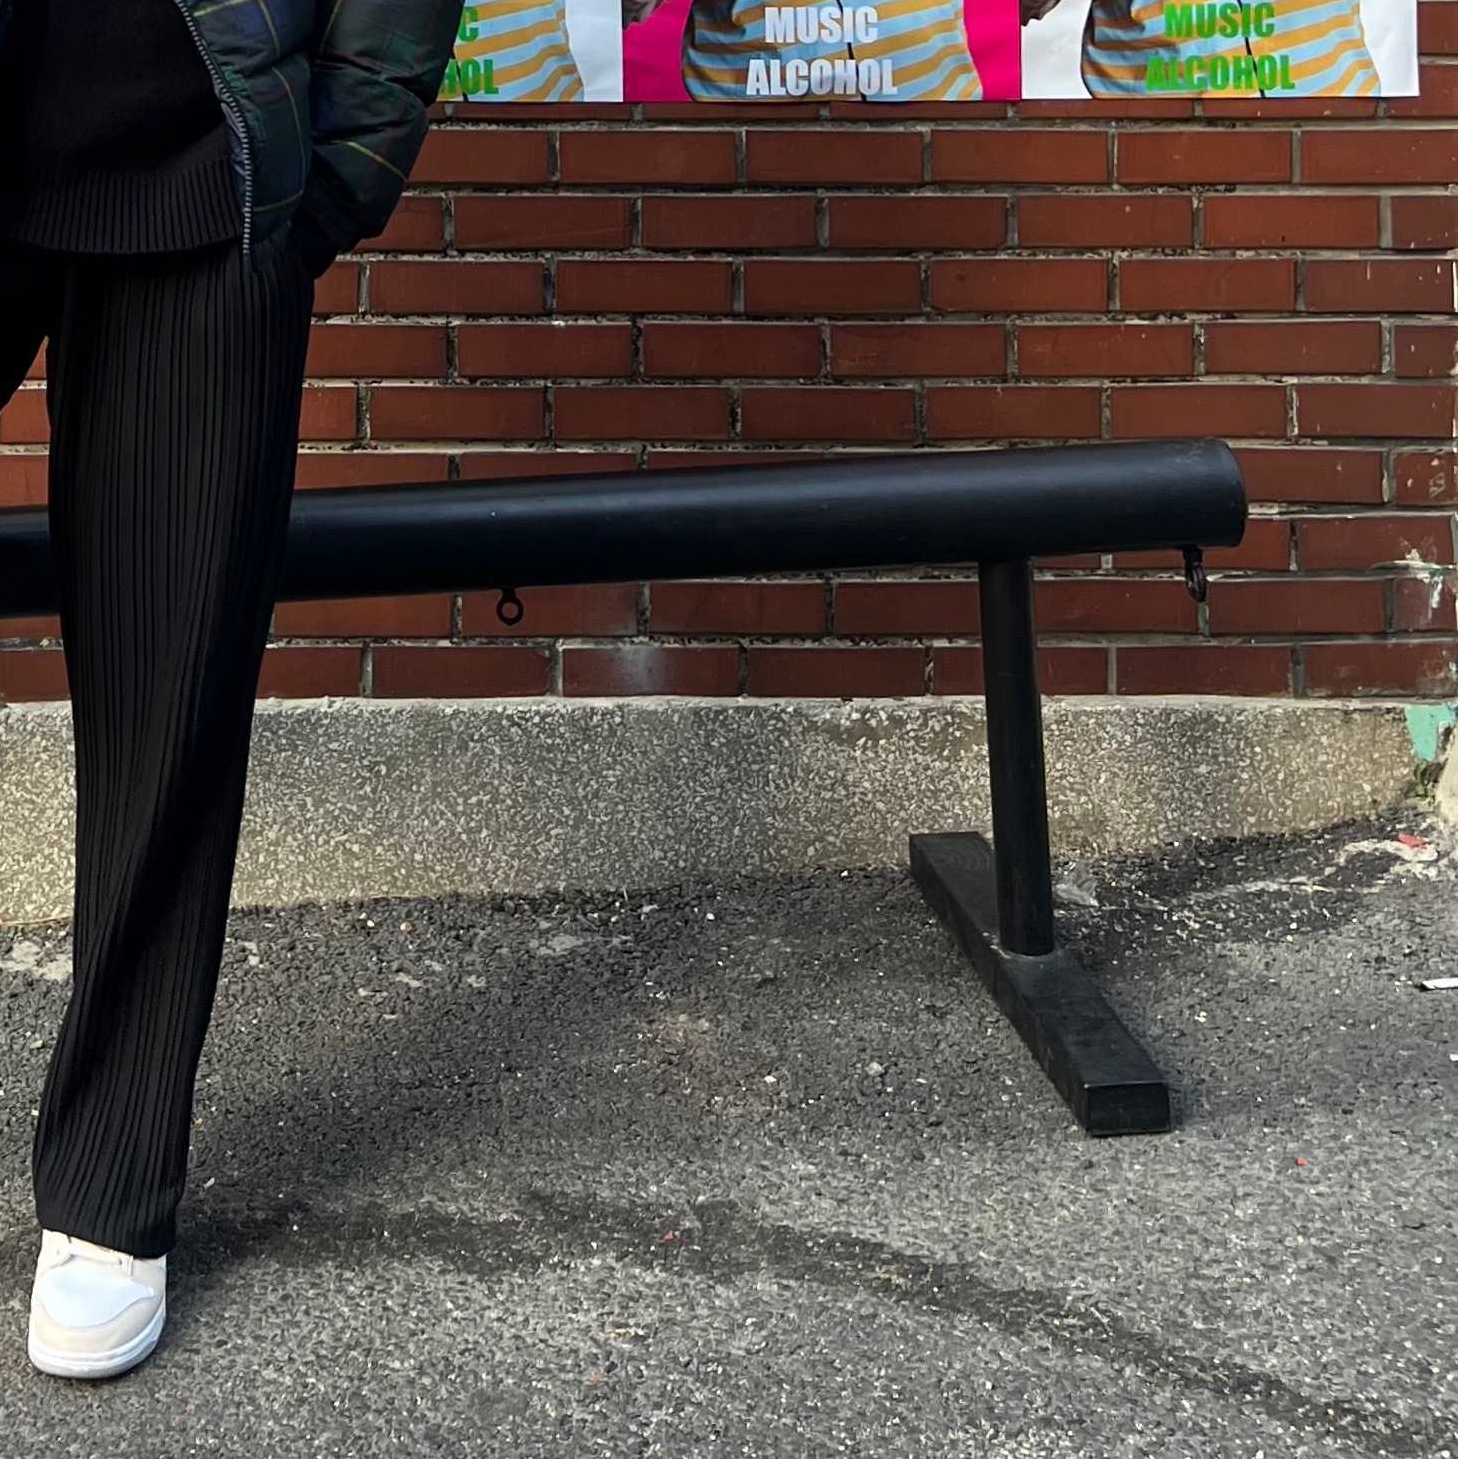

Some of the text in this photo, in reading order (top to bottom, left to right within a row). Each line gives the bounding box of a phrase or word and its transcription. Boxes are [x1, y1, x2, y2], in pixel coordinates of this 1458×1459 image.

[765, 6, 878, 44] MUSIC
[1164, 1, 1275, 38] MUSIC
[746, 58, 898, 96] ALCOHOL
[1146, 53, 1296, 90] ALCOHOL
